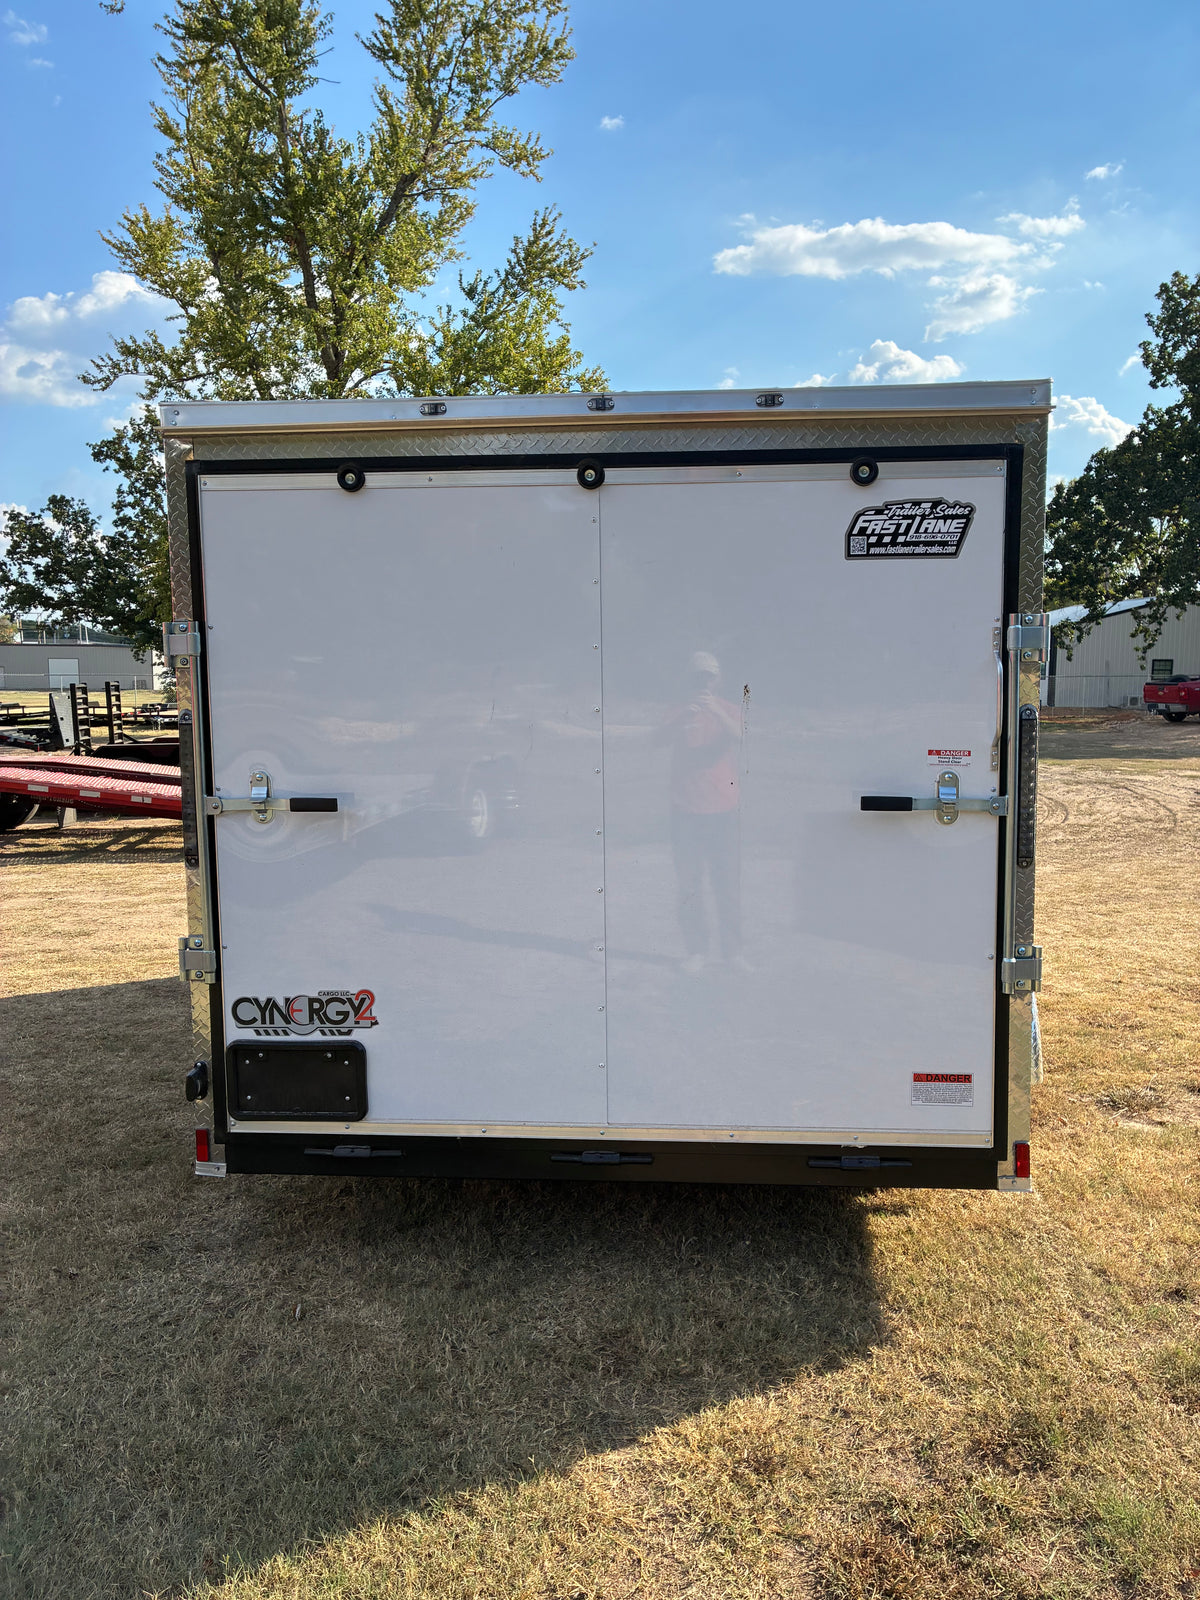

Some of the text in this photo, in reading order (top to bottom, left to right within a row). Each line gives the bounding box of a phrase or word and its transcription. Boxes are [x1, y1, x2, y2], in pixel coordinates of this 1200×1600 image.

[886, 504, 972, 518] Trailer Sales
[869, 544, 957, 554] www.fastlanetrailersales.com
[926, 1074, 971, 1082] DANGER
